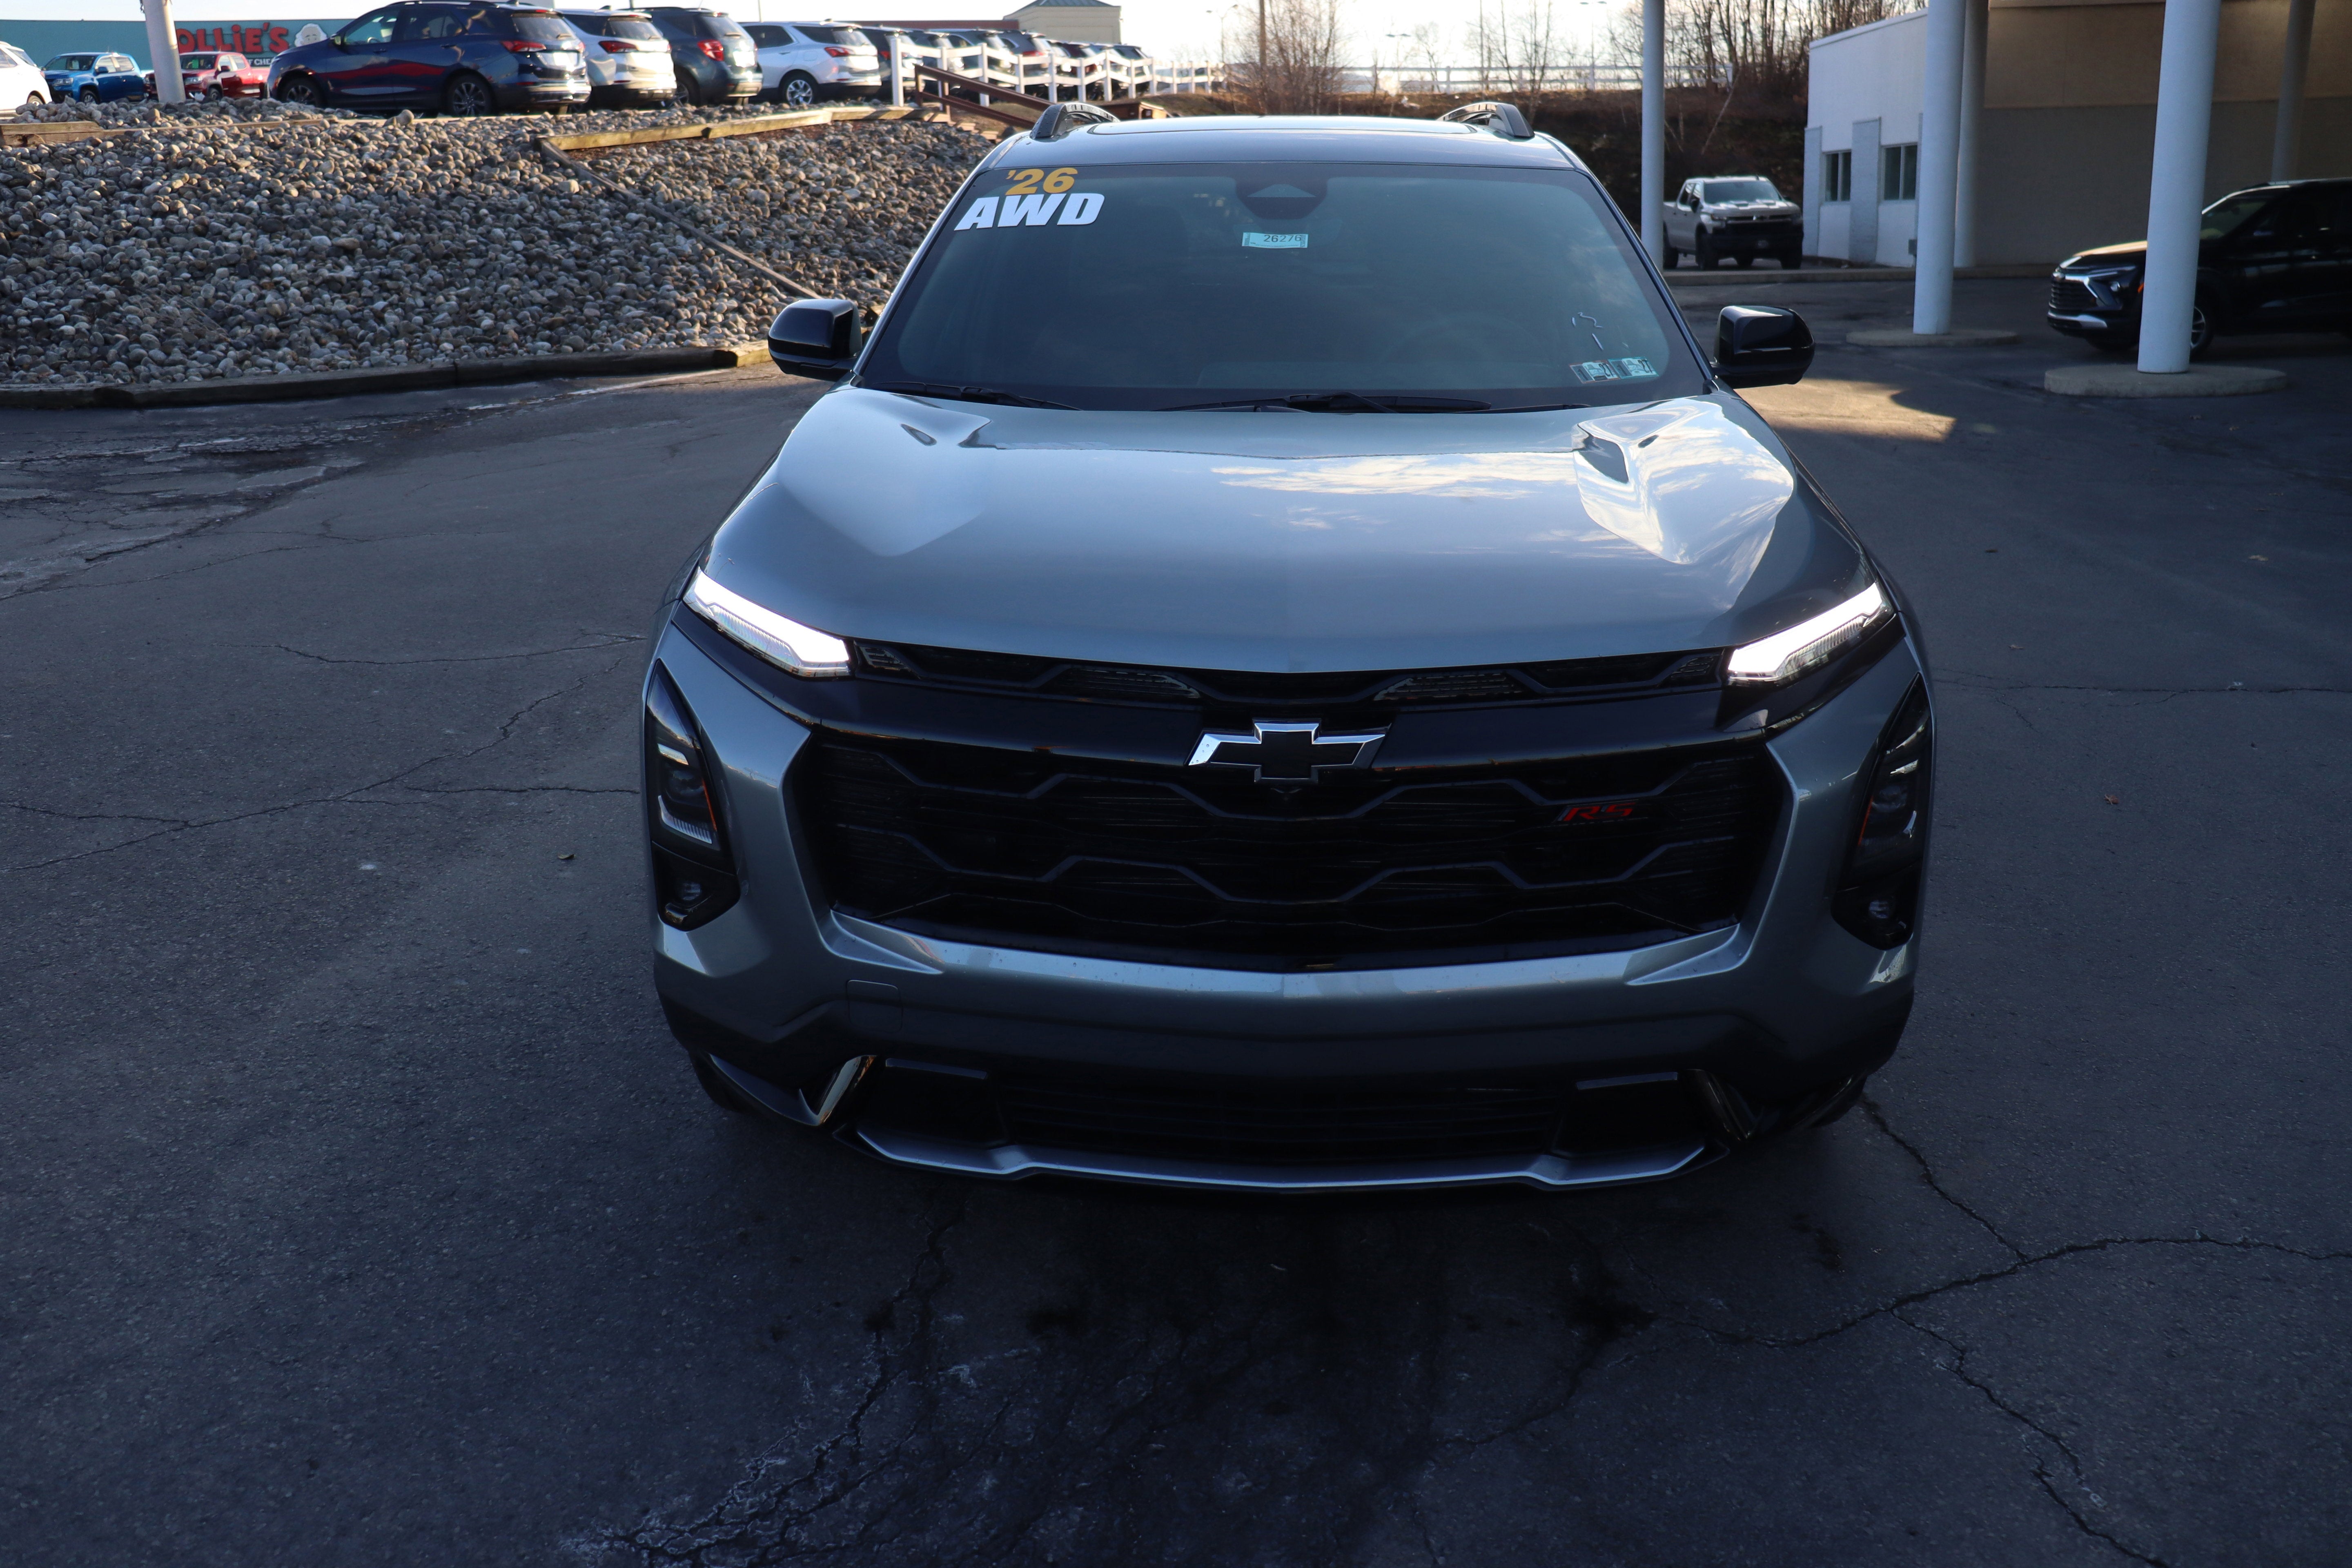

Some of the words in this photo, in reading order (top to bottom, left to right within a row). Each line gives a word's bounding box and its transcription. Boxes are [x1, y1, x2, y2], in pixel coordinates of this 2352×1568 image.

[1005, 167, 1078, 196] '26
[954, 193, 1105, 231] AWD
[1263, 234, 1302, 243] 26276
[1561, 802, 1636, 821] RS
